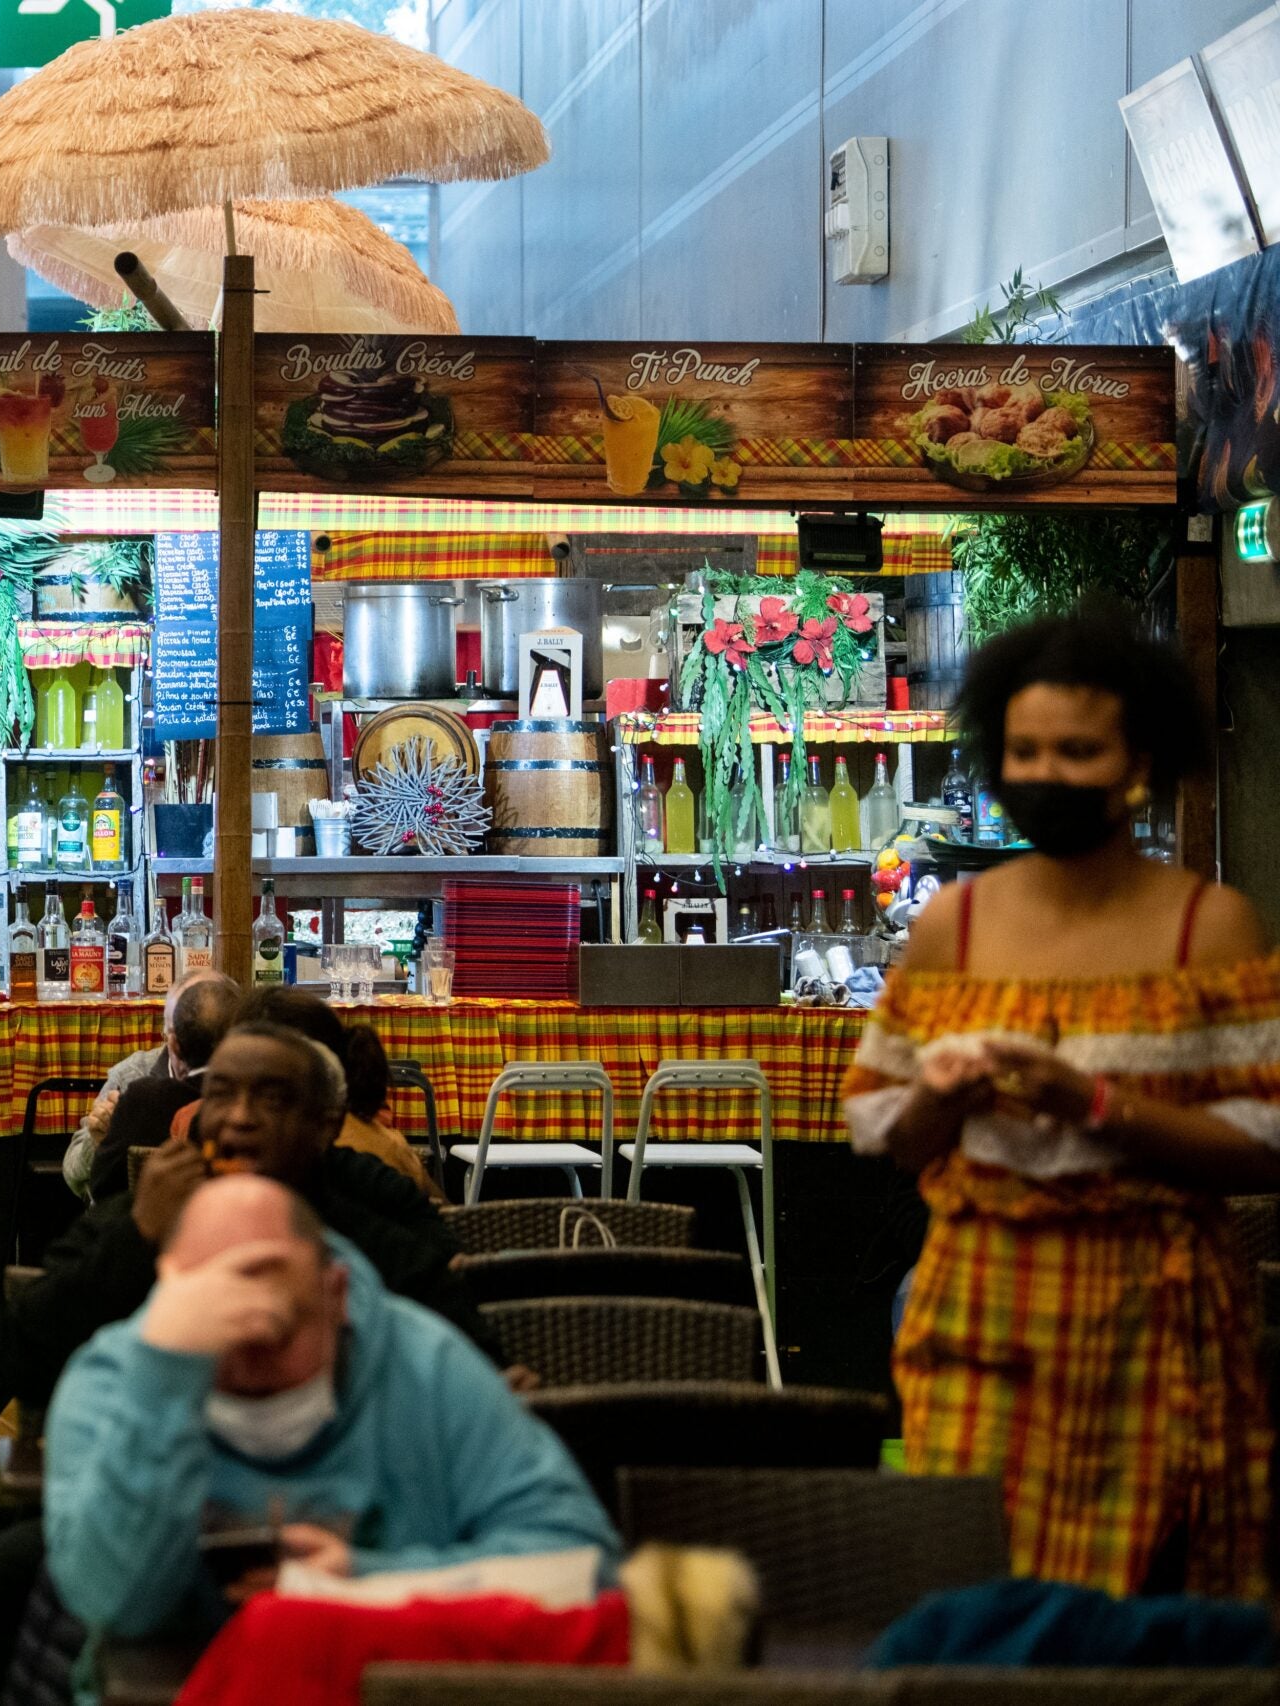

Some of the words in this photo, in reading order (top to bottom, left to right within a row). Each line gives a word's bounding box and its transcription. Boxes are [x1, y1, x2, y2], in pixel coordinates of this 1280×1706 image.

[32, 339, 63, 372] de
[72, 342, 147, 382] Fruits
[280, 338, 386, 382] Boudins
[395, 341, 476, 382] Créole
[901, 360, 992, 401] Accras
[1000, 353, 1031, 385] de
[1039, 356, 1130, 399] Morue
[73, 402, 108, 419] sans
[116, 394, 186, 421] Alcool
